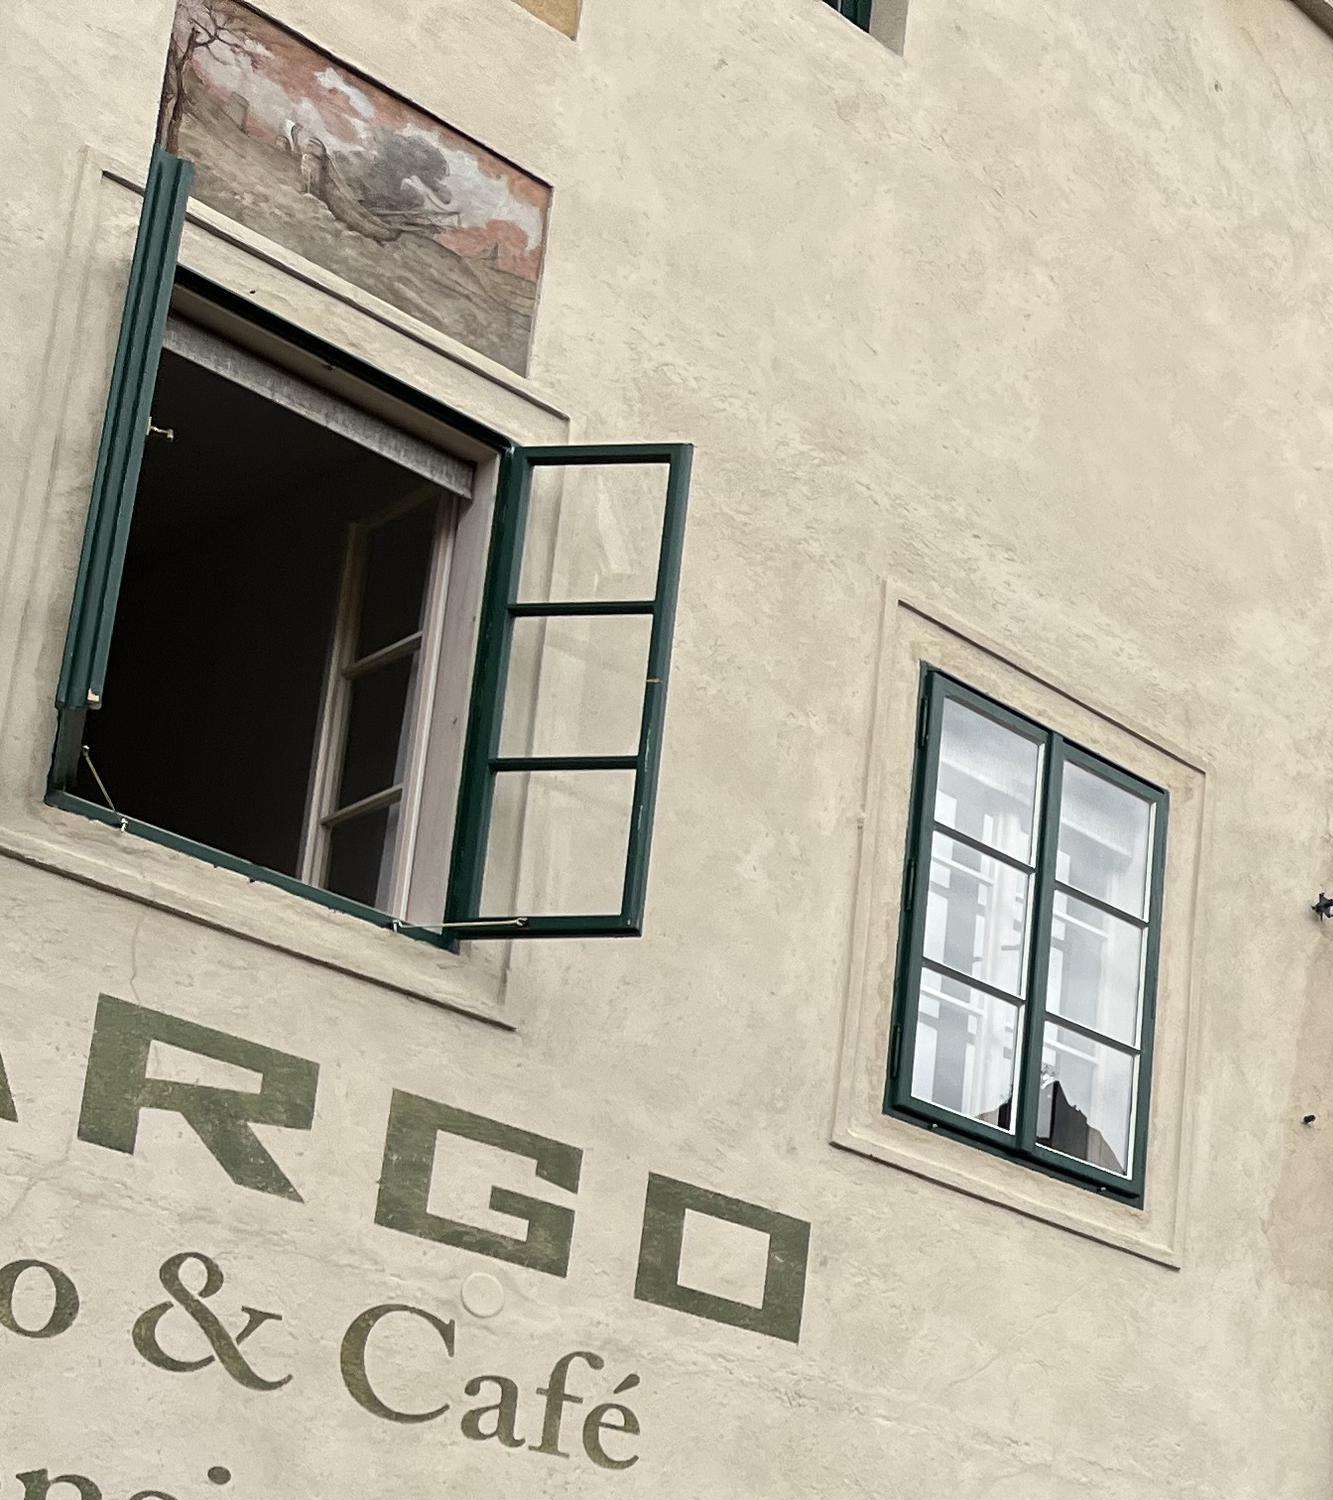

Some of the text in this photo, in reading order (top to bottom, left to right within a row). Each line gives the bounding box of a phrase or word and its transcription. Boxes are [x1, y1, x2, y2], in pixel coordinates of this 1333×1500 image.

[0, 993, 812, 1344] RGO
[131, 1250, 293, 1392] &
[339, 1303, 642, 1471] Café
